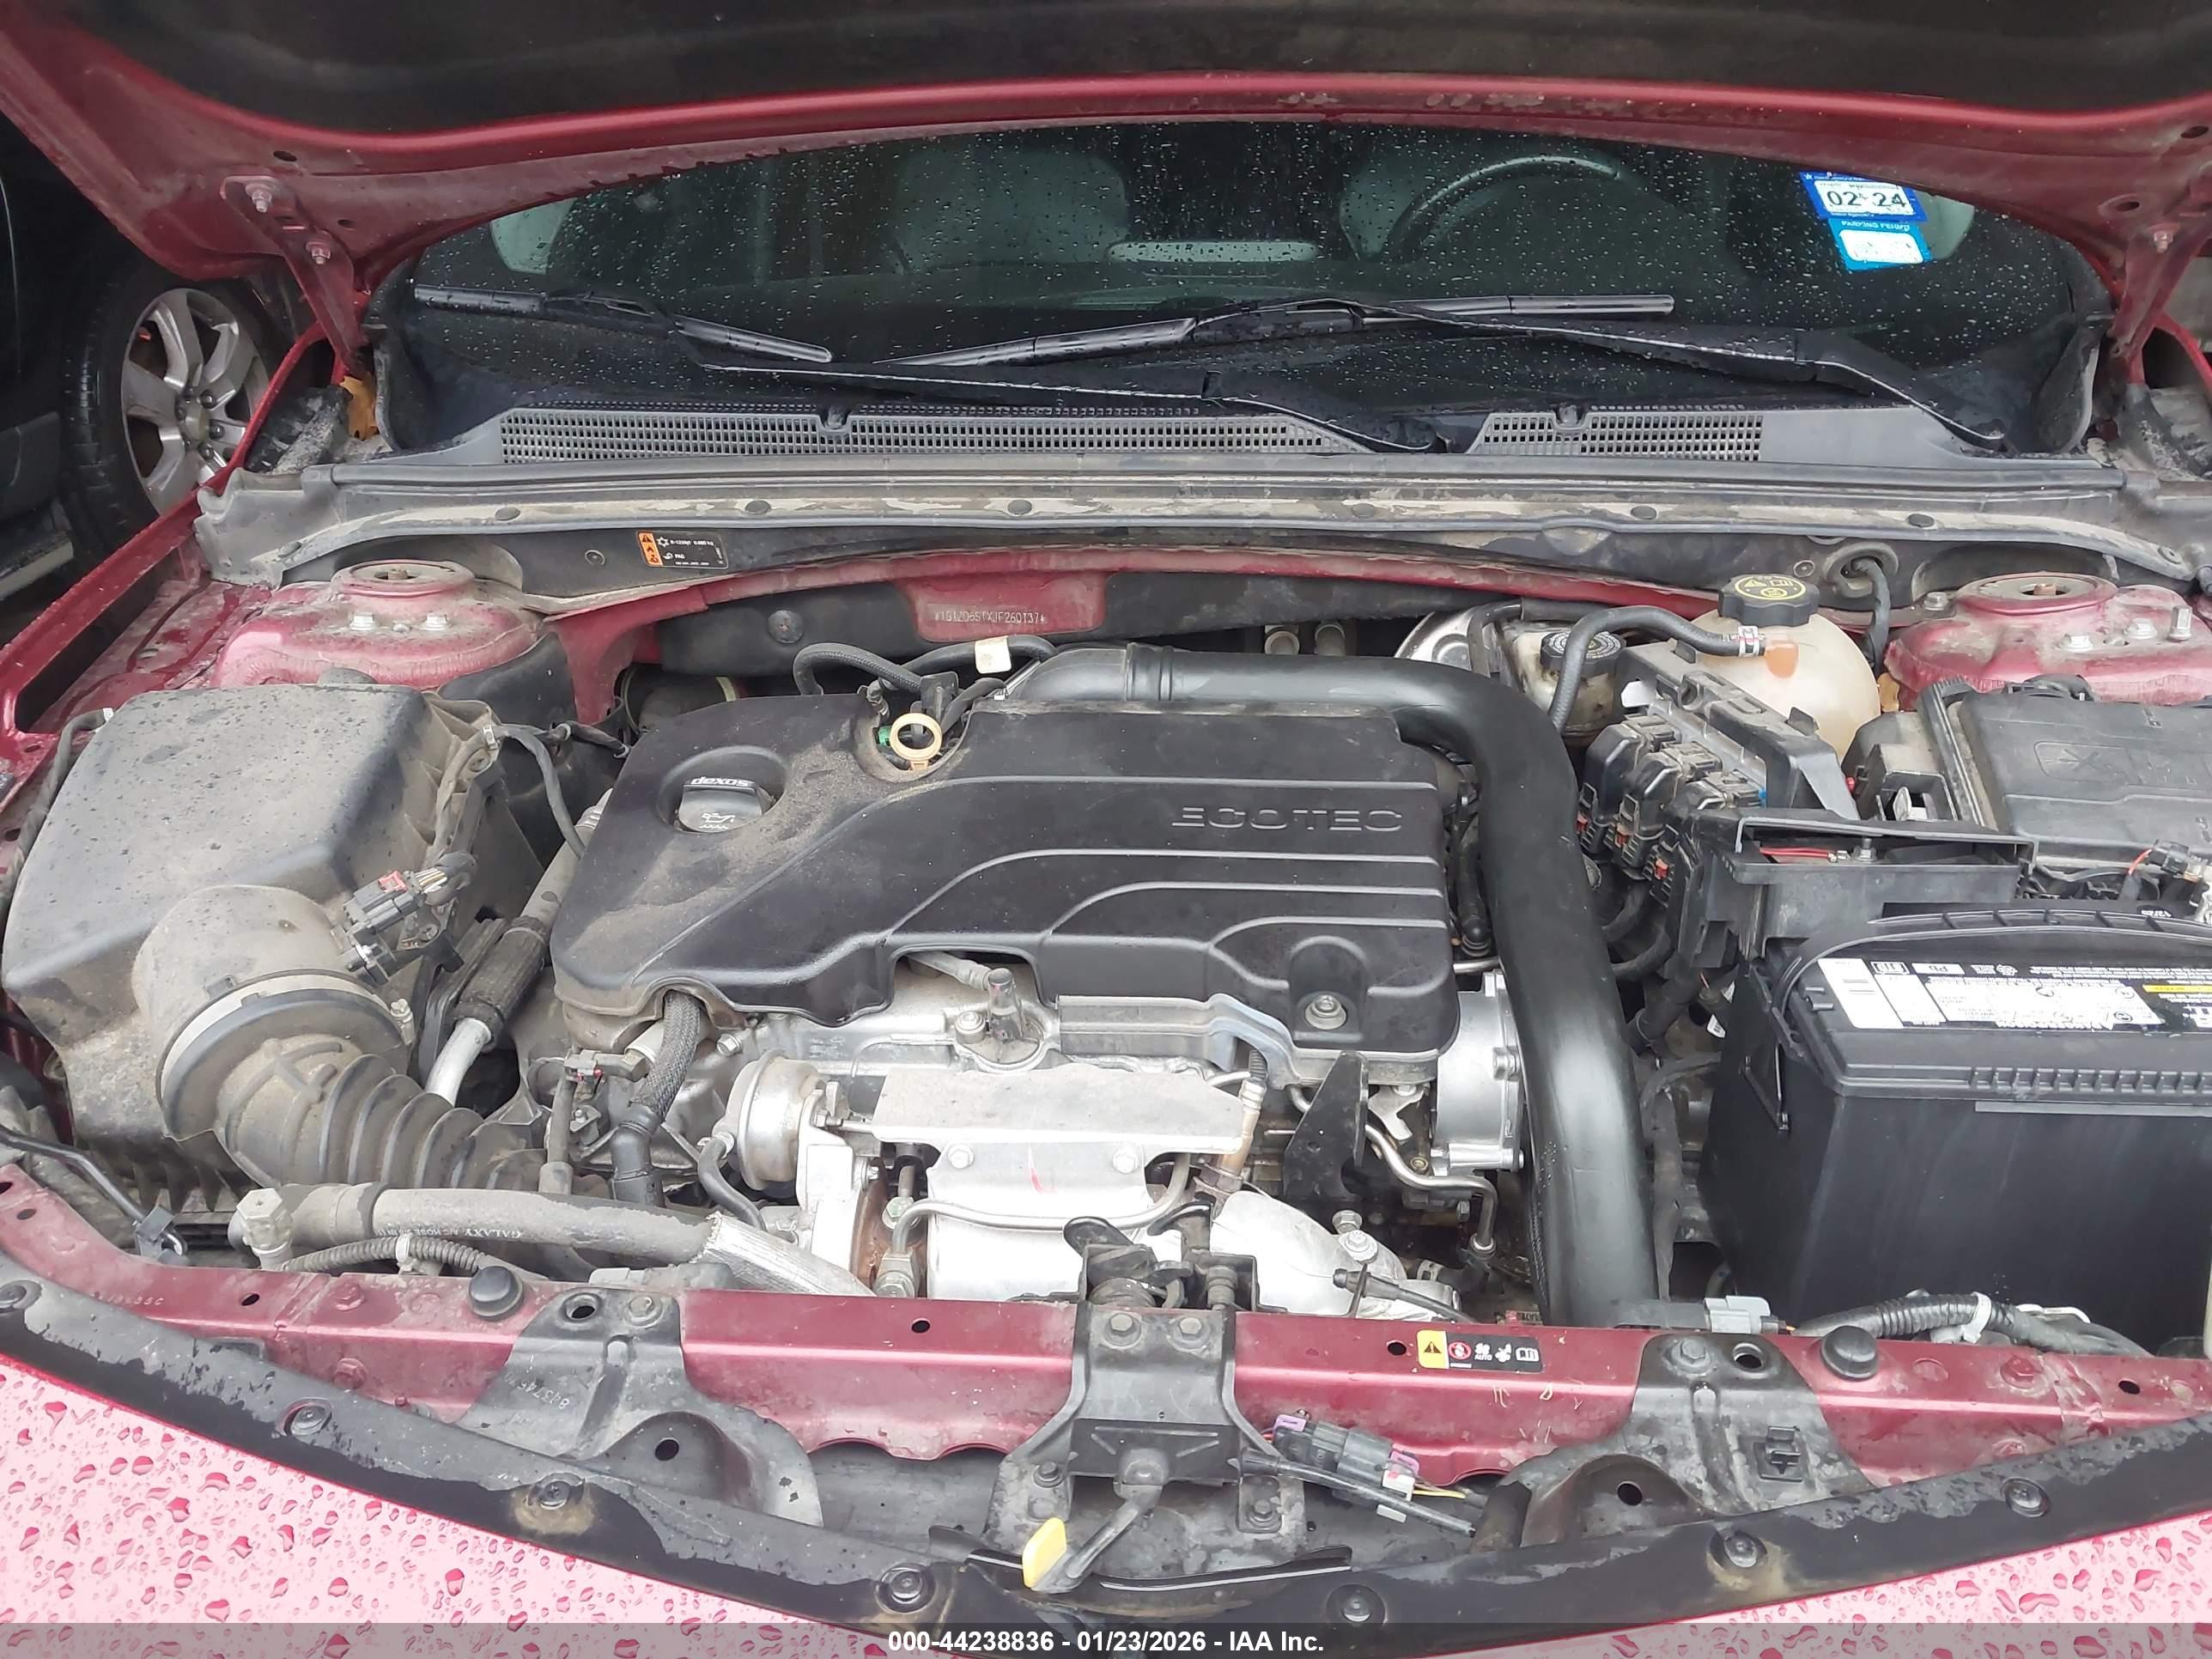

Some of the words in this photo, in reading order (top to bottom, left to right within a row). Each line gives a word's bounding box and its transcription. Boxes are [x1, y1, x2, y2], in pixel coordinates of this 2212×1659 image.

[1826, 191, 1862, 206] 02
[1872, 191, 1907, 208] 24
[690, 776, 756, 787] dexos
[1171, 806, 1401, 831] ECOTEC
[464, 1228, 523, 1239] GALAXY
